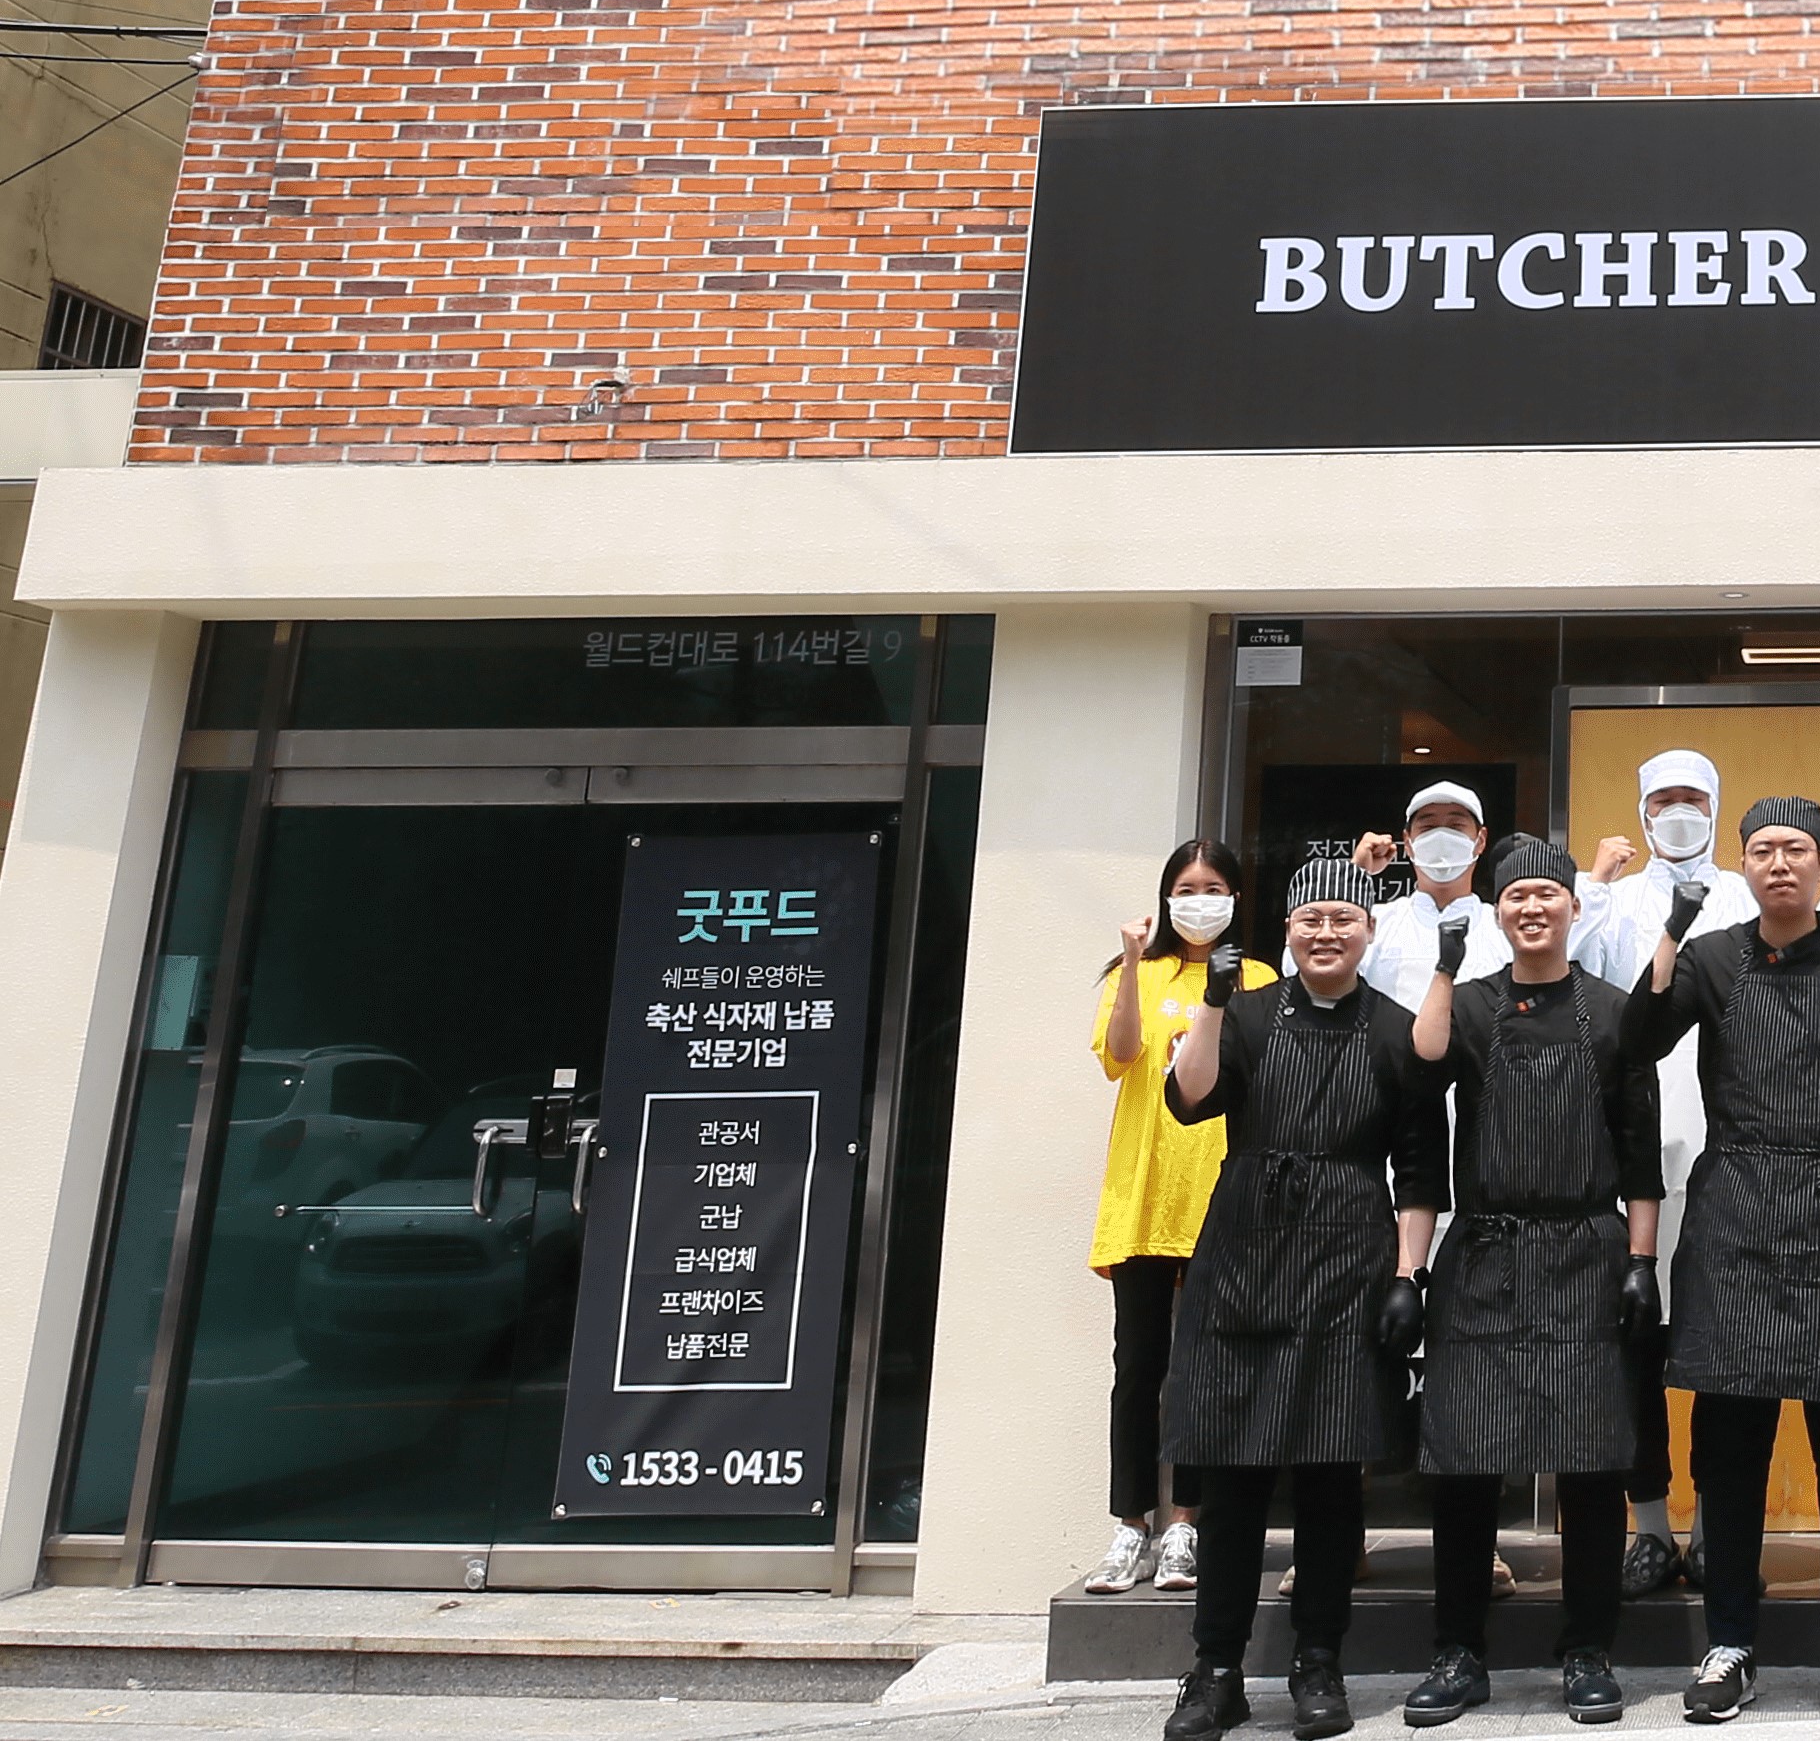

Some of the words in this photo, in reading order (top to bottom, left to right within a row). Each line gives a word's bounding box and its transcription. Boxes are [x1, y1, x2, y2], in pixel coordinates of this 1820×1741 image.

[1255, 230, 1817, 313] BUTCHER
[583, 631, 739, 667] 월드컵대로
[753, 629, 871, 665] 114번길
[676, 889, 820, 944] 굿푸드
[661, 965, 741, 990] 쉐프들이
[744, 964, 826, 988] 운영하는
[644, 1002, 697, 1033] 축산
[702, 1001, 777, 1033] 식자재
[783, 999, 836, 1030] 납품
[686, 1037, 788, 1069] 전문기업
[698, 1120, 761, 1146] 관공서
[693, 1161, 757, 1187] 기업체
[699, 1204, 742, 1230] 군납
[674, 1246, 756, 1273] 급식업체
[665, 1332, 750, 1360] 납품전문
